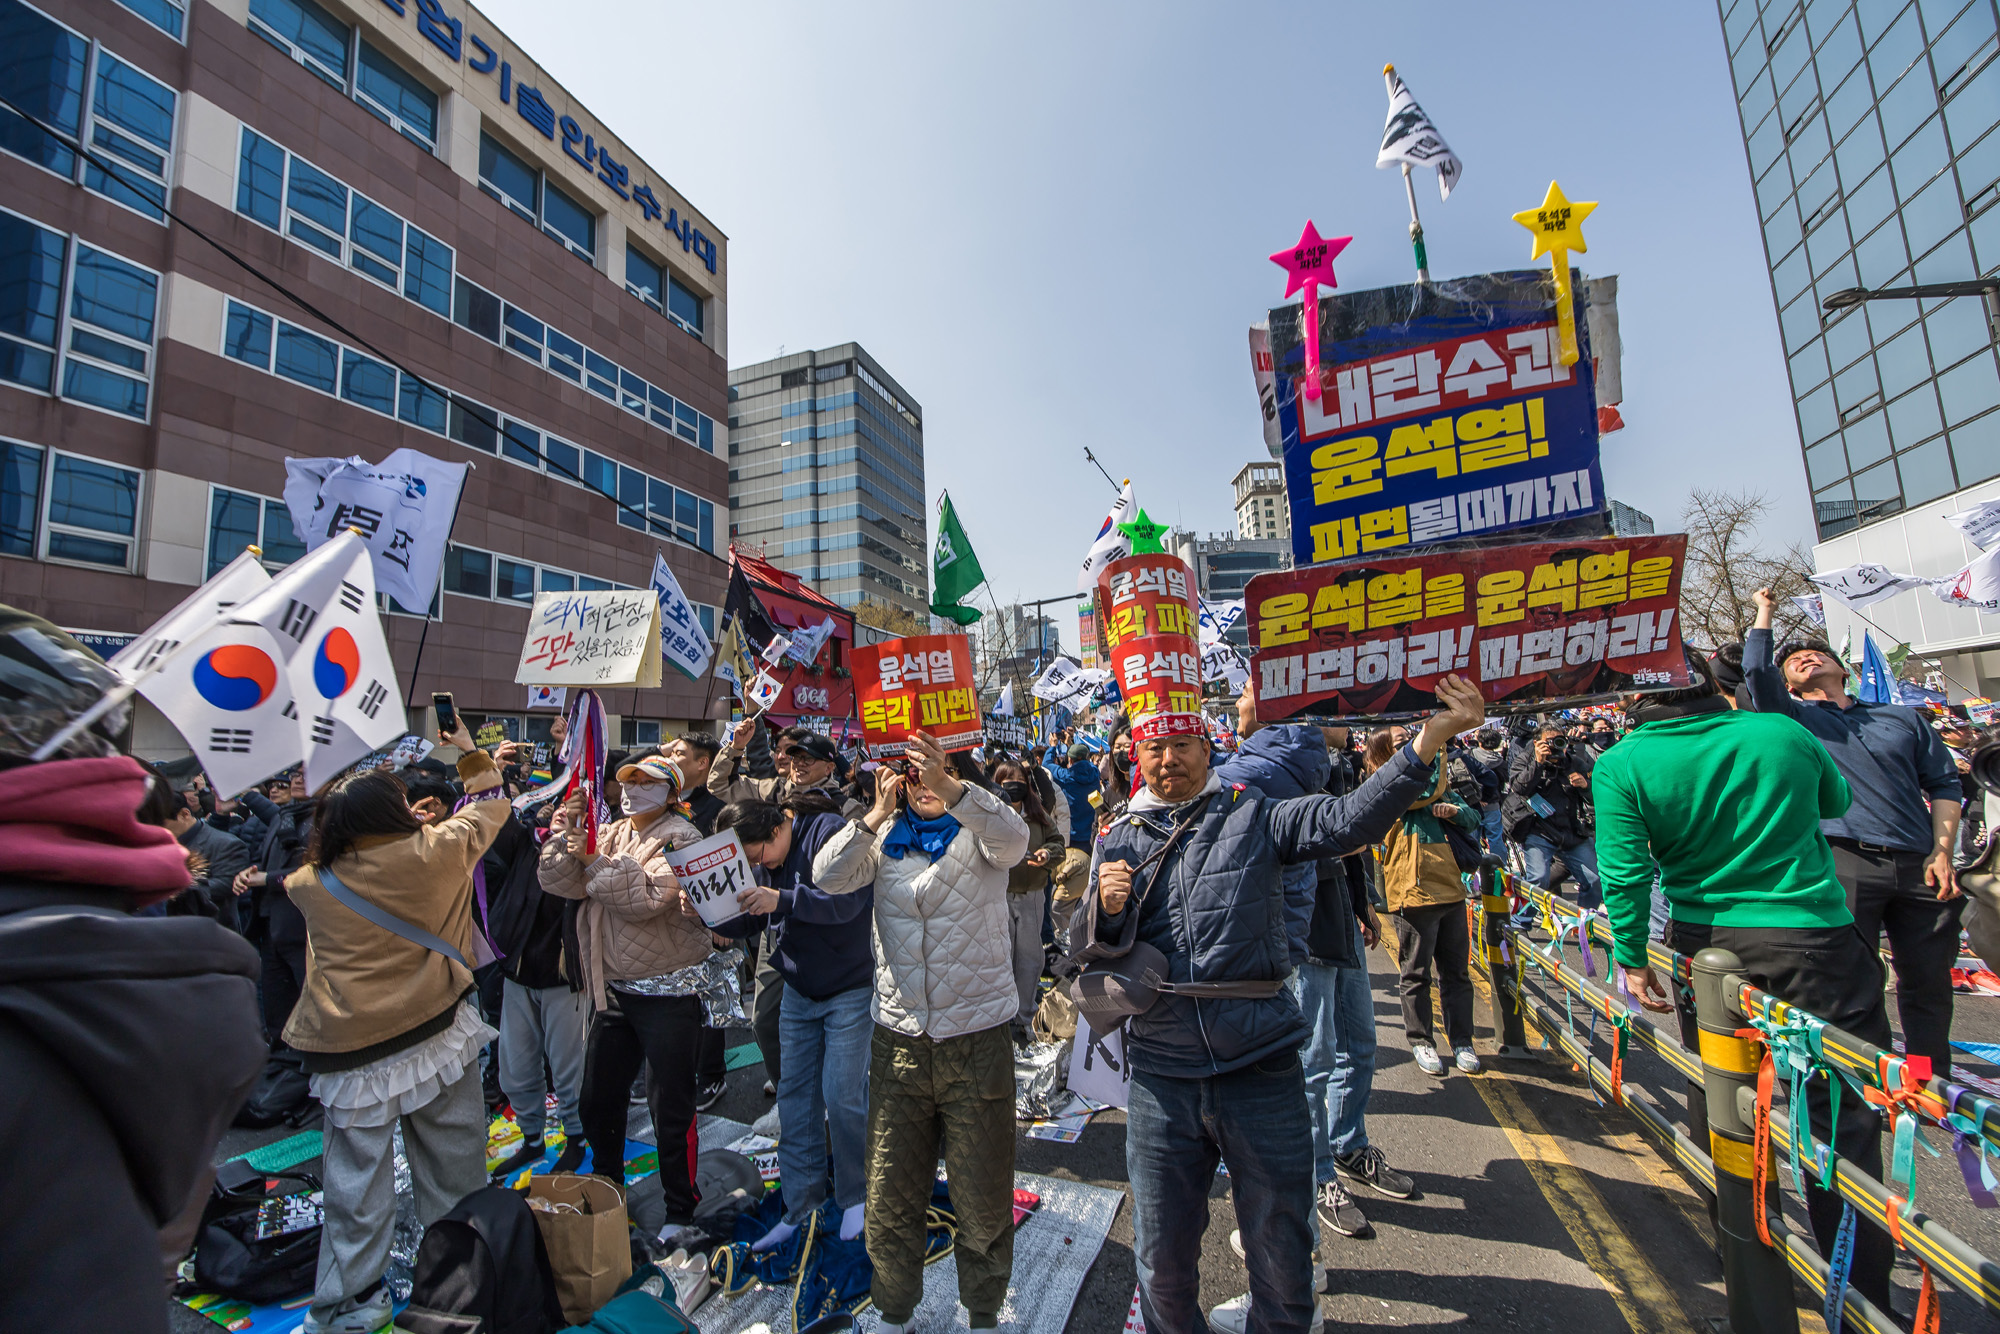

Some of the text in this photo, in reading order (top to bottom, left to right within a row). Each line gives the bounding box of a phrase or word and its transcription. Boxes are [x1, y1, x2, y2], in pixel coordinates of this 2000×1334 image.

[1537, 207, 1571, 223] 윤석열
[1543, 219, 1566, 232] 파면
[1294, 244, 1327, 261] 윤석열
[1300, 257, 1322, 270] 파면
[1301, 326, 1570, 437] 내란수괴
[1310, 397, 1550, 506] 윤석열!
[1134, 524, 1155, 532] 윤석열
[1139, 531, 1153, 539] 파면
[1109, 566, 1189, 607] 윤석열
[1259, 568, 1466, 648] 윤석열을
[1477, 550, 1674, 628] 윤석열을
[543, 595, 600, 633] 역사적
[524, 630, 576, 671] 그만
[878, 649, 956, 692] 윤석열
[1259, 608, 1676, 700] 파면하라! 파면하라!
[1123, 651, 1200, 691] 윤석열
[1632, 672, 1671, 684] 민주당
[863, 687, 977, 733] 즉각 파면!
